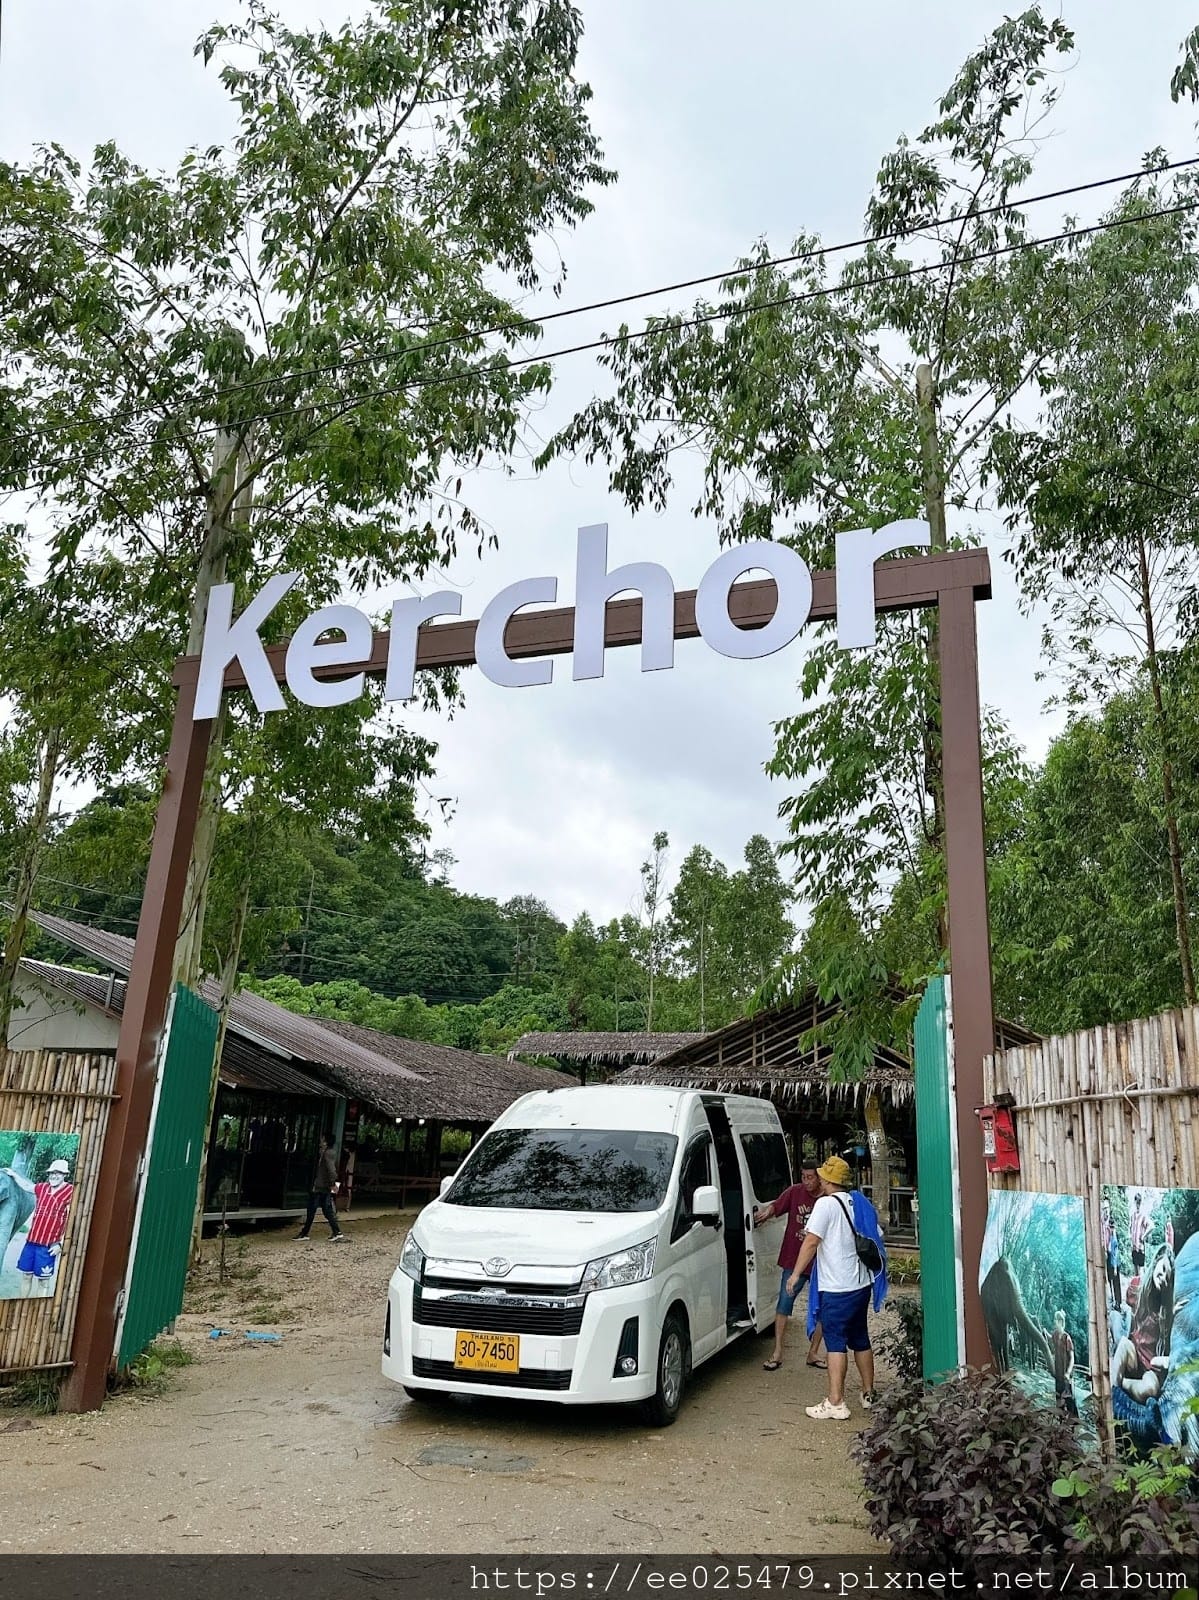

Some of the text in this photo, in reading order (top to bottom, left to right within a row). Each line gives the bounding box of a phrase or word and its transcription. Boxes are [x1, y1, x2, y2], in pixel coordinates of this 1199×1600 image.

[193, 518, 931, 720] Kerchor
[471, 1333, 505, 1341] THAILAND
[459, 1340, 515, 1361] 30-7450
